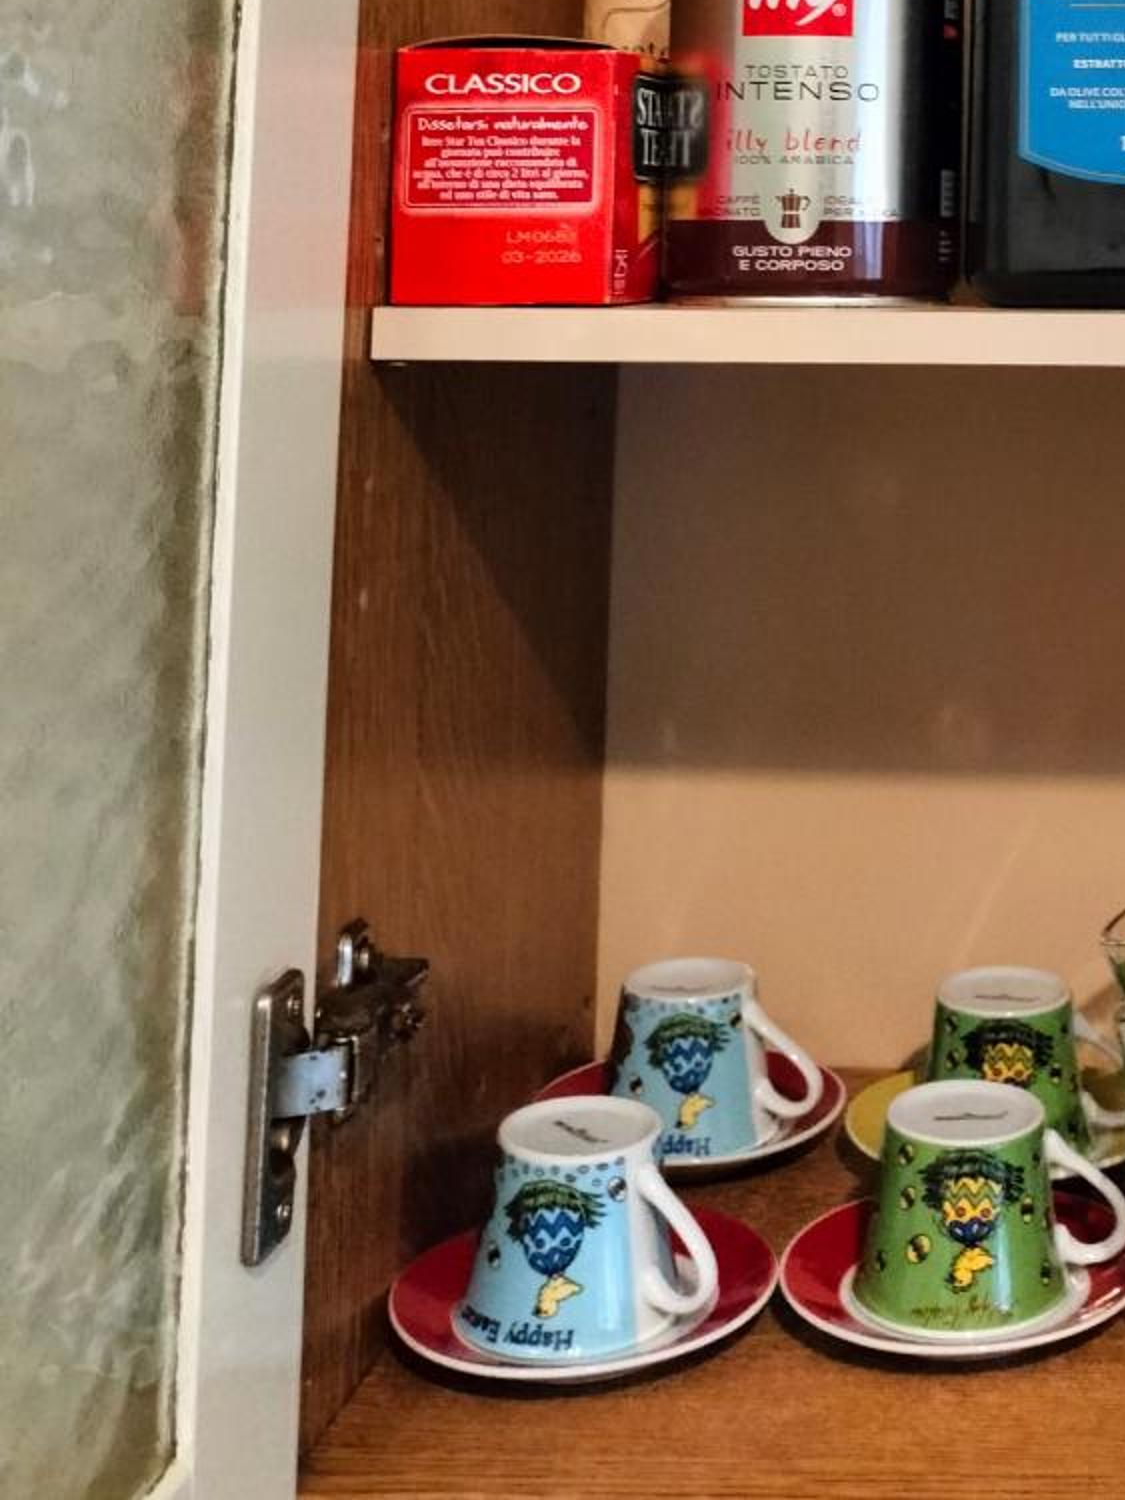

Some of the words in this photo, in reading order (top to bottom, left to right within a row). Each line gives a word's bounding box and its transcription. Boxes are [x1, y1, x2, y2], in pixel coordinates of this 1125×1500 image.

[744, 64, 849, 79] TOSTATO
[425, 73, 583, 95] CLASSICO
[717, 80, 880, 102] INTENSO
[728, 128, 769, 153] illy
[786, 126, 862, 153] blend
[778, 154, 856, 165] ARABICA
[732, 245, 794, 258] GUSTO
[797, 245, 853, 258] PIENO
[739, 259, 751, 271] E
[755, 259, 846, 272] CORPOSO
[502, 1321, 575, 1352] Happy
